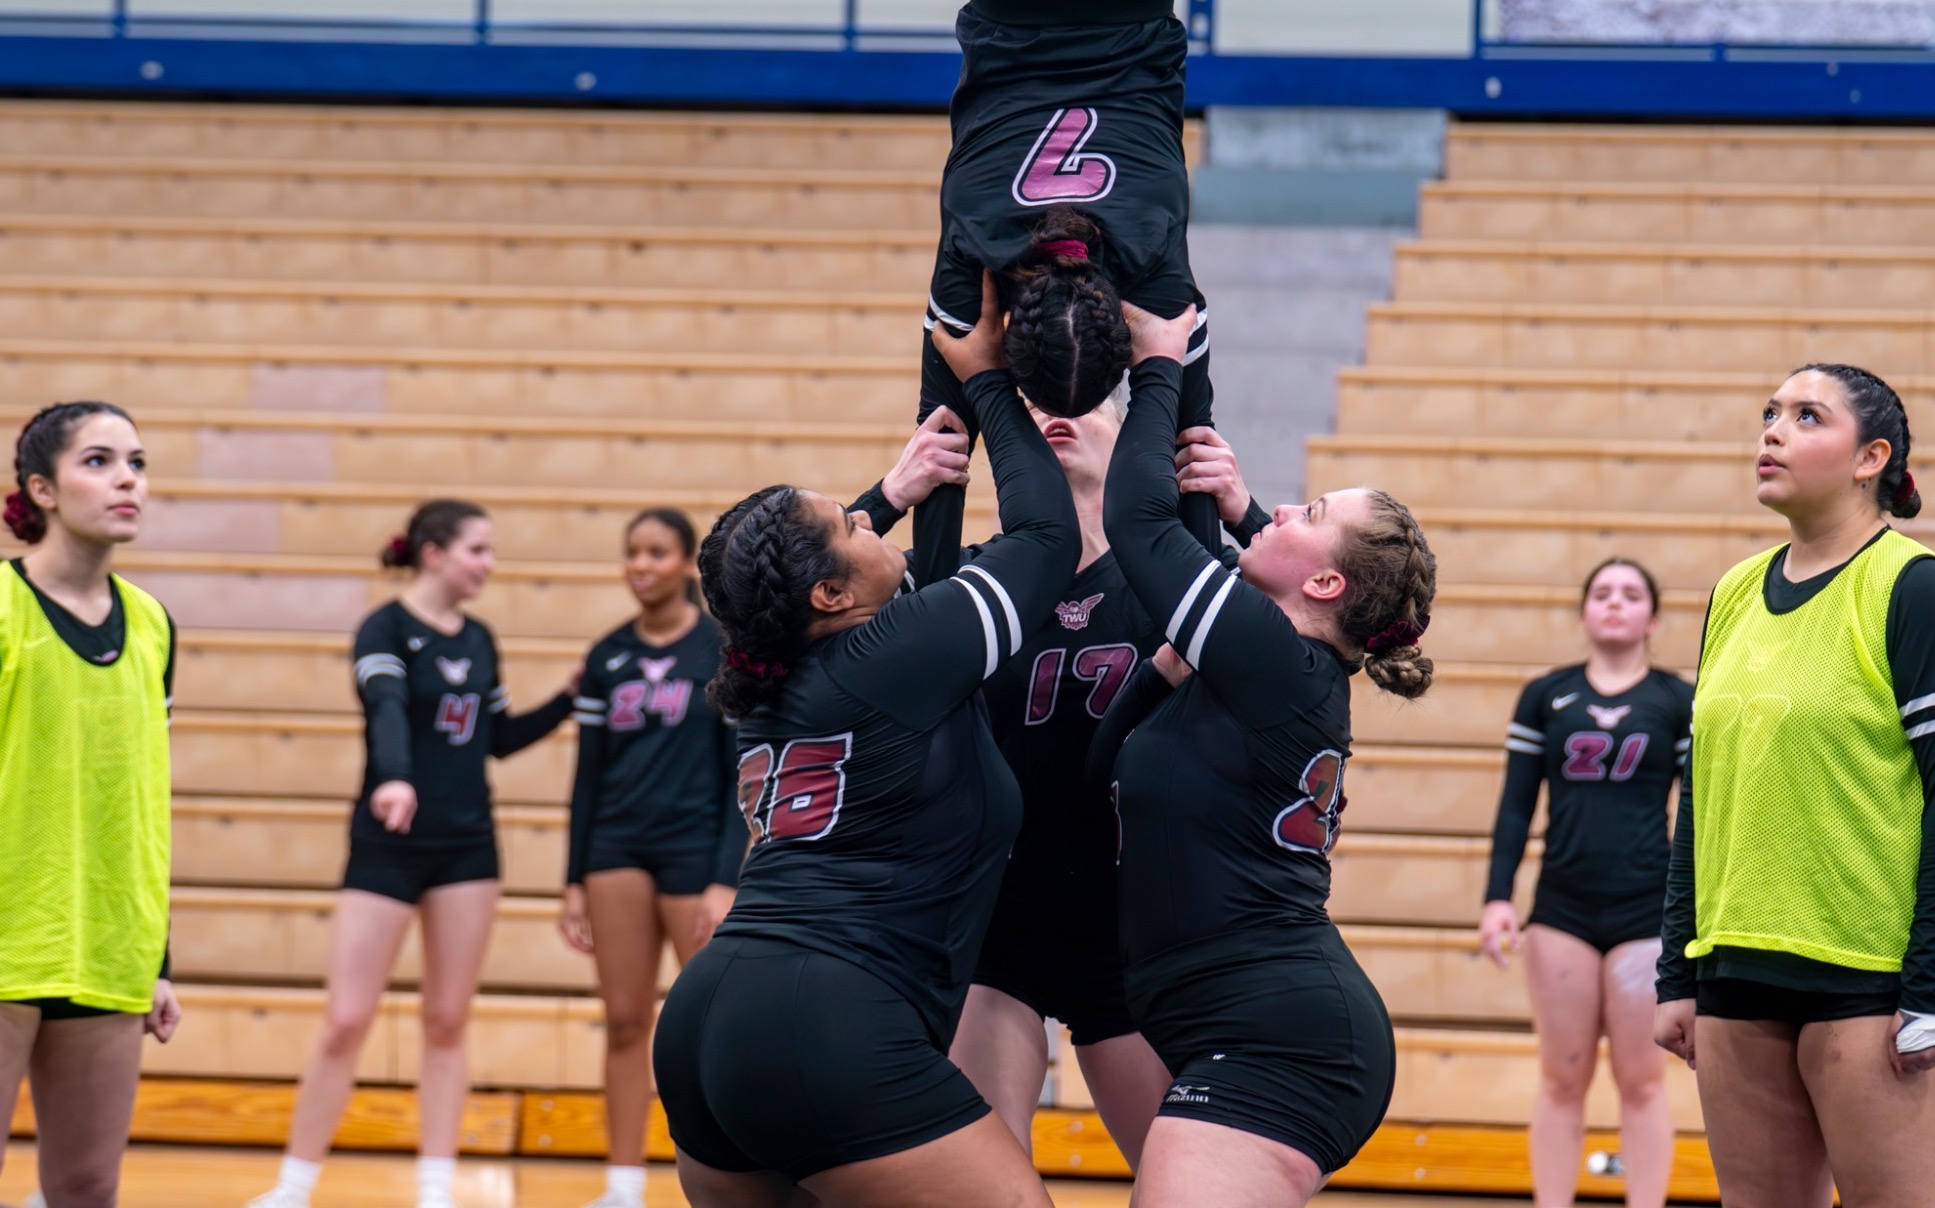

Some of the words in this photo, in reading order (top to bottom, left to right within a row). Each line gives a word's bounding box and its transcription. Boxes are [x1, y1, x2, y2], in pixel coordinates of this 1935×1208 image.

[1012, 107, 1116, 206] 7
[1062, 613, 1087, 623] TWU
[607, 678, 693, 731] 24
[1025, 643, 1138, 726] 17
[434, 692, 481, 745] 4
[1561, 731, 1649, 781] 21
